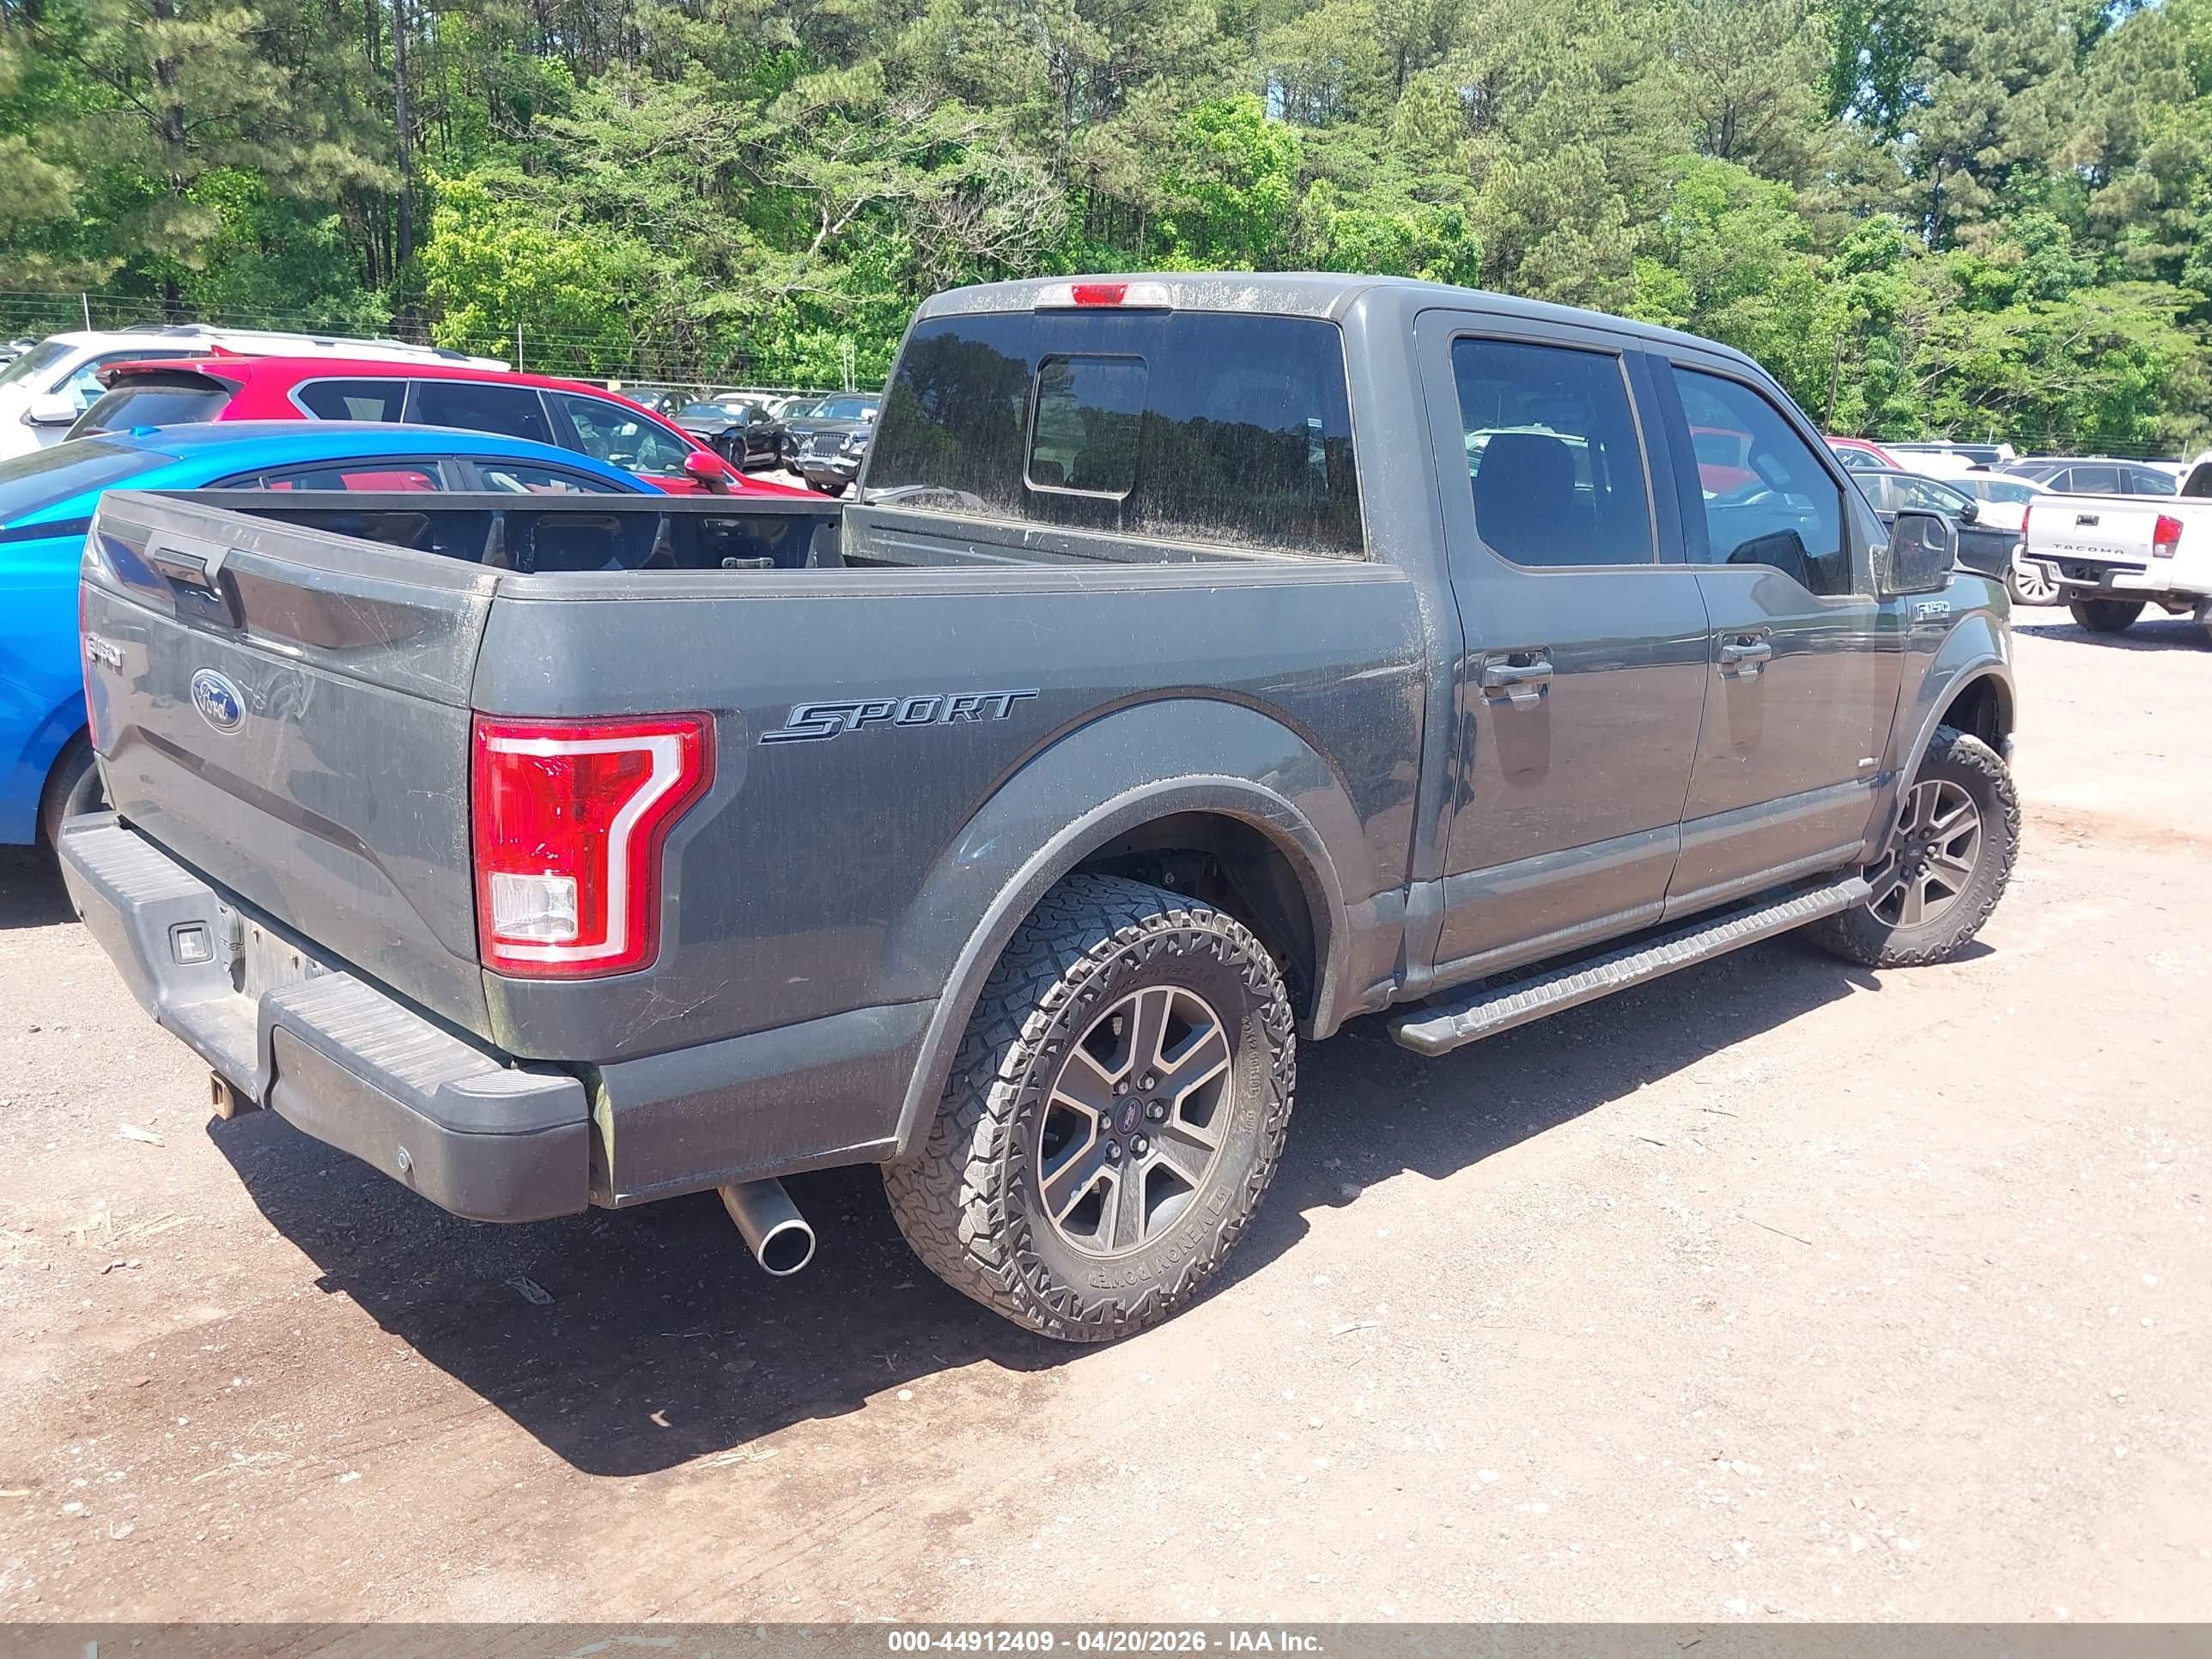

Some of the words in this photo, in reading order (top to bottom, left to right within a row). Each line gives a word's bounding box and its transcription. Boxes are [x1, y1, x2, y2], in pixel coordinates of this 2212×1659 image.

[2053, 544, 2125, 555] TACOMA
[758, 688, 1041, 745] SPORT
[1152, 1212, 1215, 1274] VENOM
[1088, 1260, 1152, 1289] POWER
